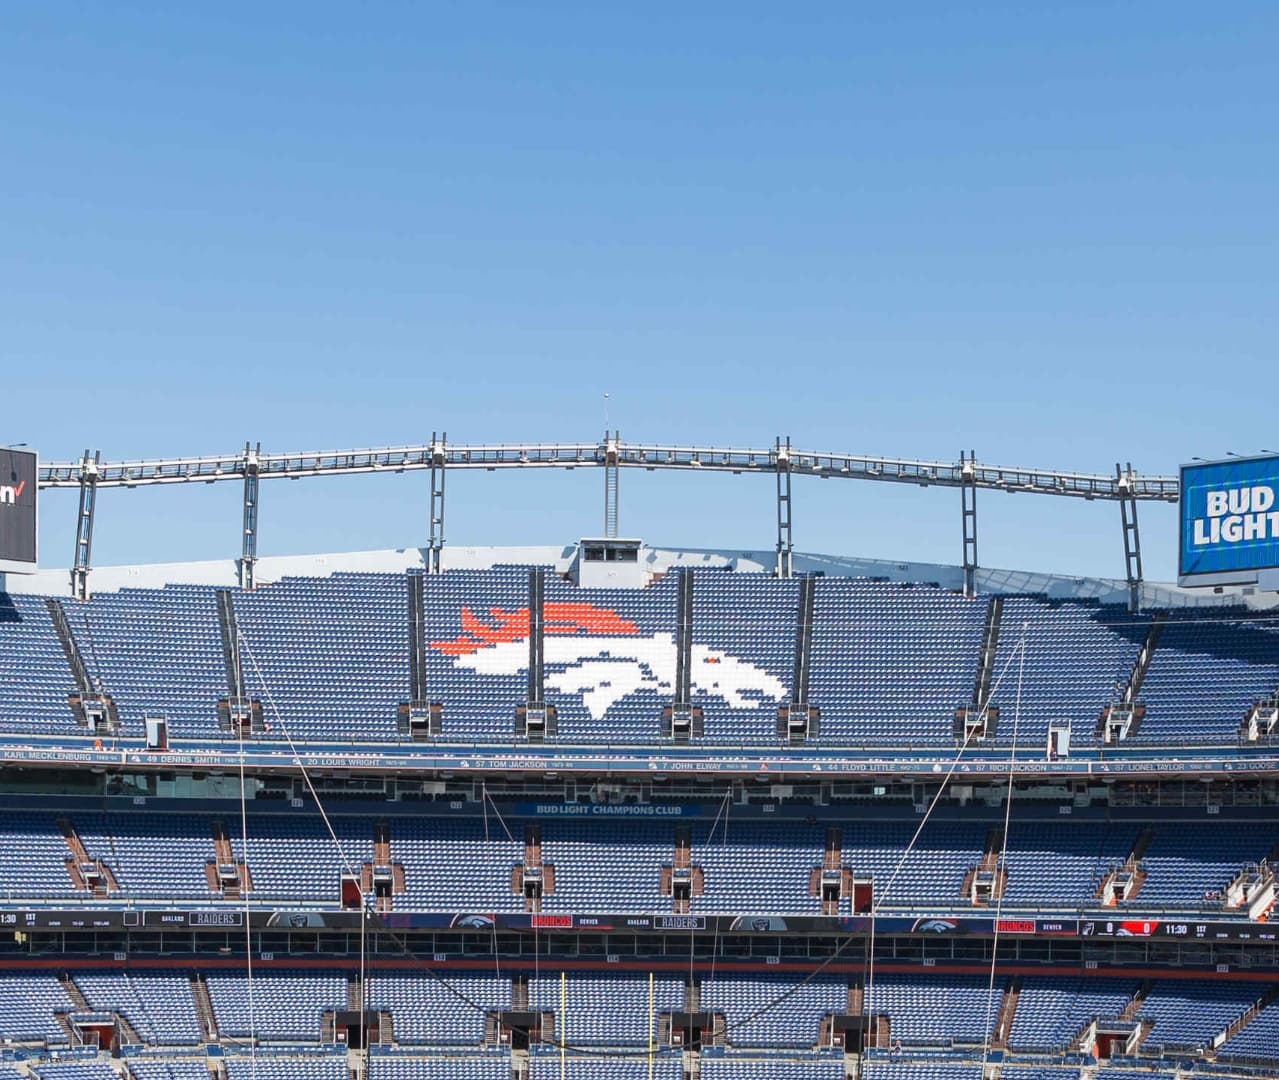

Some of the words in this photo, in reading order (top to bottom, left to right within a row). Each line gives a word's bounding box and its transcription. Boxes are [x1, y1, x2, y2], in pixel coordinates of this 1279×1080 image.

[1206, 486, 1274, 517] BUD
[4, 751, 26, 759] KARL
[29, 752, 92, 760] MECKLENBURG
[537, 805, 559, 815] BUD
[560, 805, 589, 815] LIGHT
[592, 806, 654, 815] CHAMPIONS
[655, 806, 682, 815] CLUB
[197, 914, 234, 924] RAIDERS
[532, 916, 571, 926] BRONCOS
[662, 917, 698, 928] RAIDERS
[1107, 923, 1112, 932] 0
[1144, 924, 1150, 933] 0
[1166, 925, 1187, 934] 11:30
